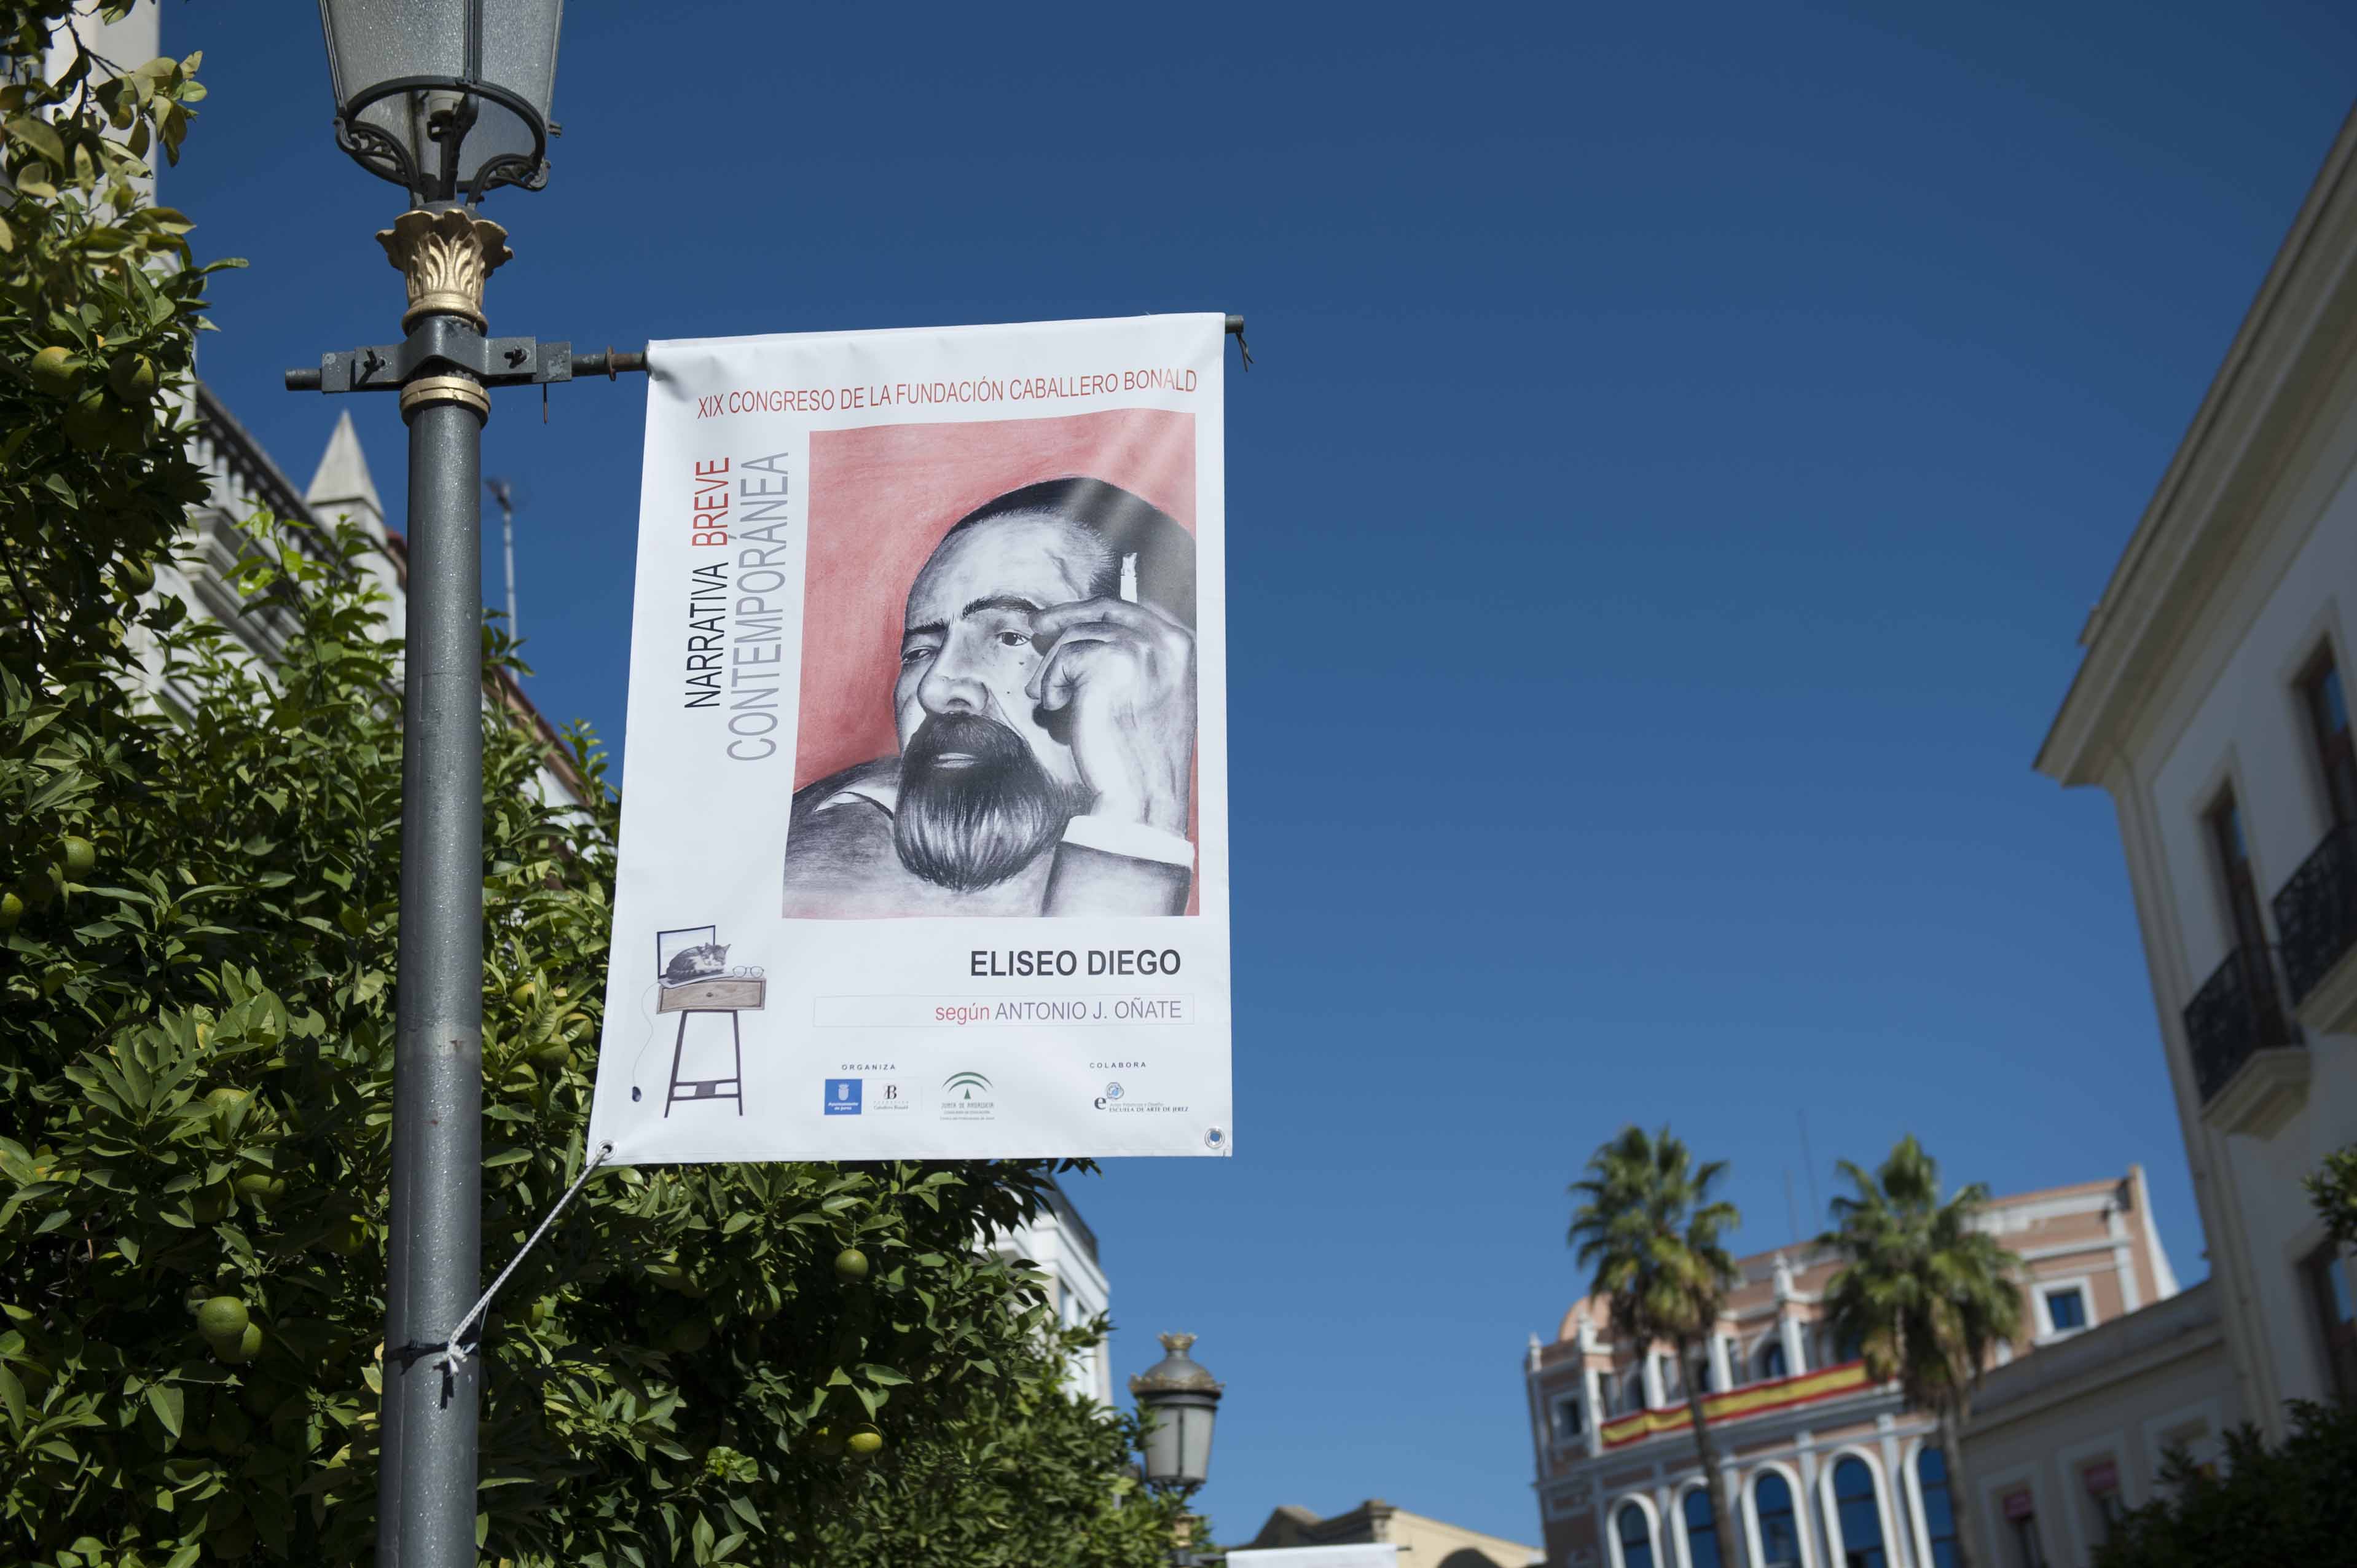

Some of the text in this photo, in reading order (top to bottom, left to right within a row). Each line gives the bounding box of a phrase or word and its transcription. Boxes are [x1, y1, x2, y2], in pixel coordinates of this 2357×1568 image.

[697, 368, 1198, 420] XIX CONGRESO DE LA FUNDACIÓN CABALLERO BONALD
[684, 457, 730, 708] NARRATIVA BREVE
[726, 452, 789, 761] CONTEMPORÁNEA
[970, 949, 1182, 977] ELISEO DIEGO
[935, 997, 1182, 1025] según ANTONIO J. OÑATE
